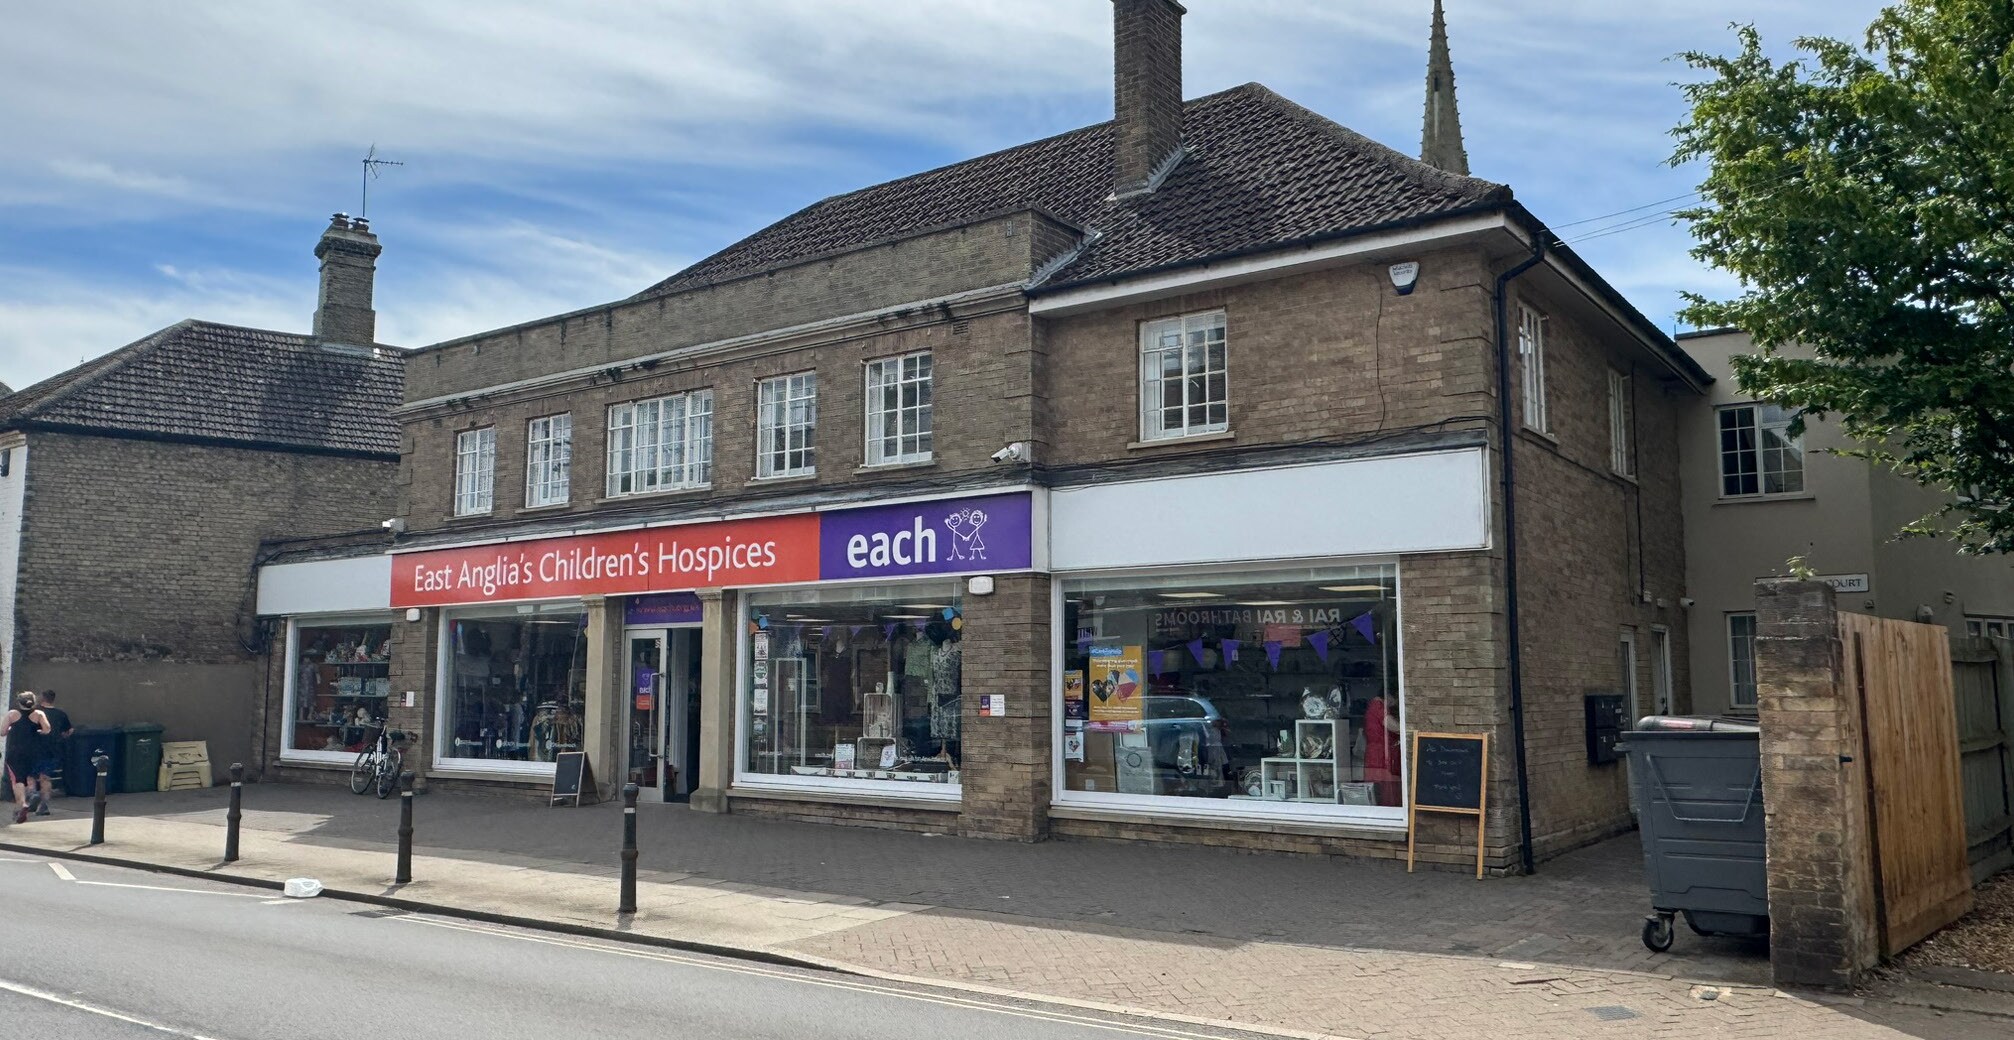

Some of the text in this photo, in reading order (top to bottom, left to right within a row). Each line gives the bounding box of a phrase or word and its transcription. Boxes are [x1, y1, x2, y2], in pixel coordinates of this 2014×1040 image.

[414, 535, 776, 596] East Anglia's Children's Hospices
[847, 516, 936, 568] each
